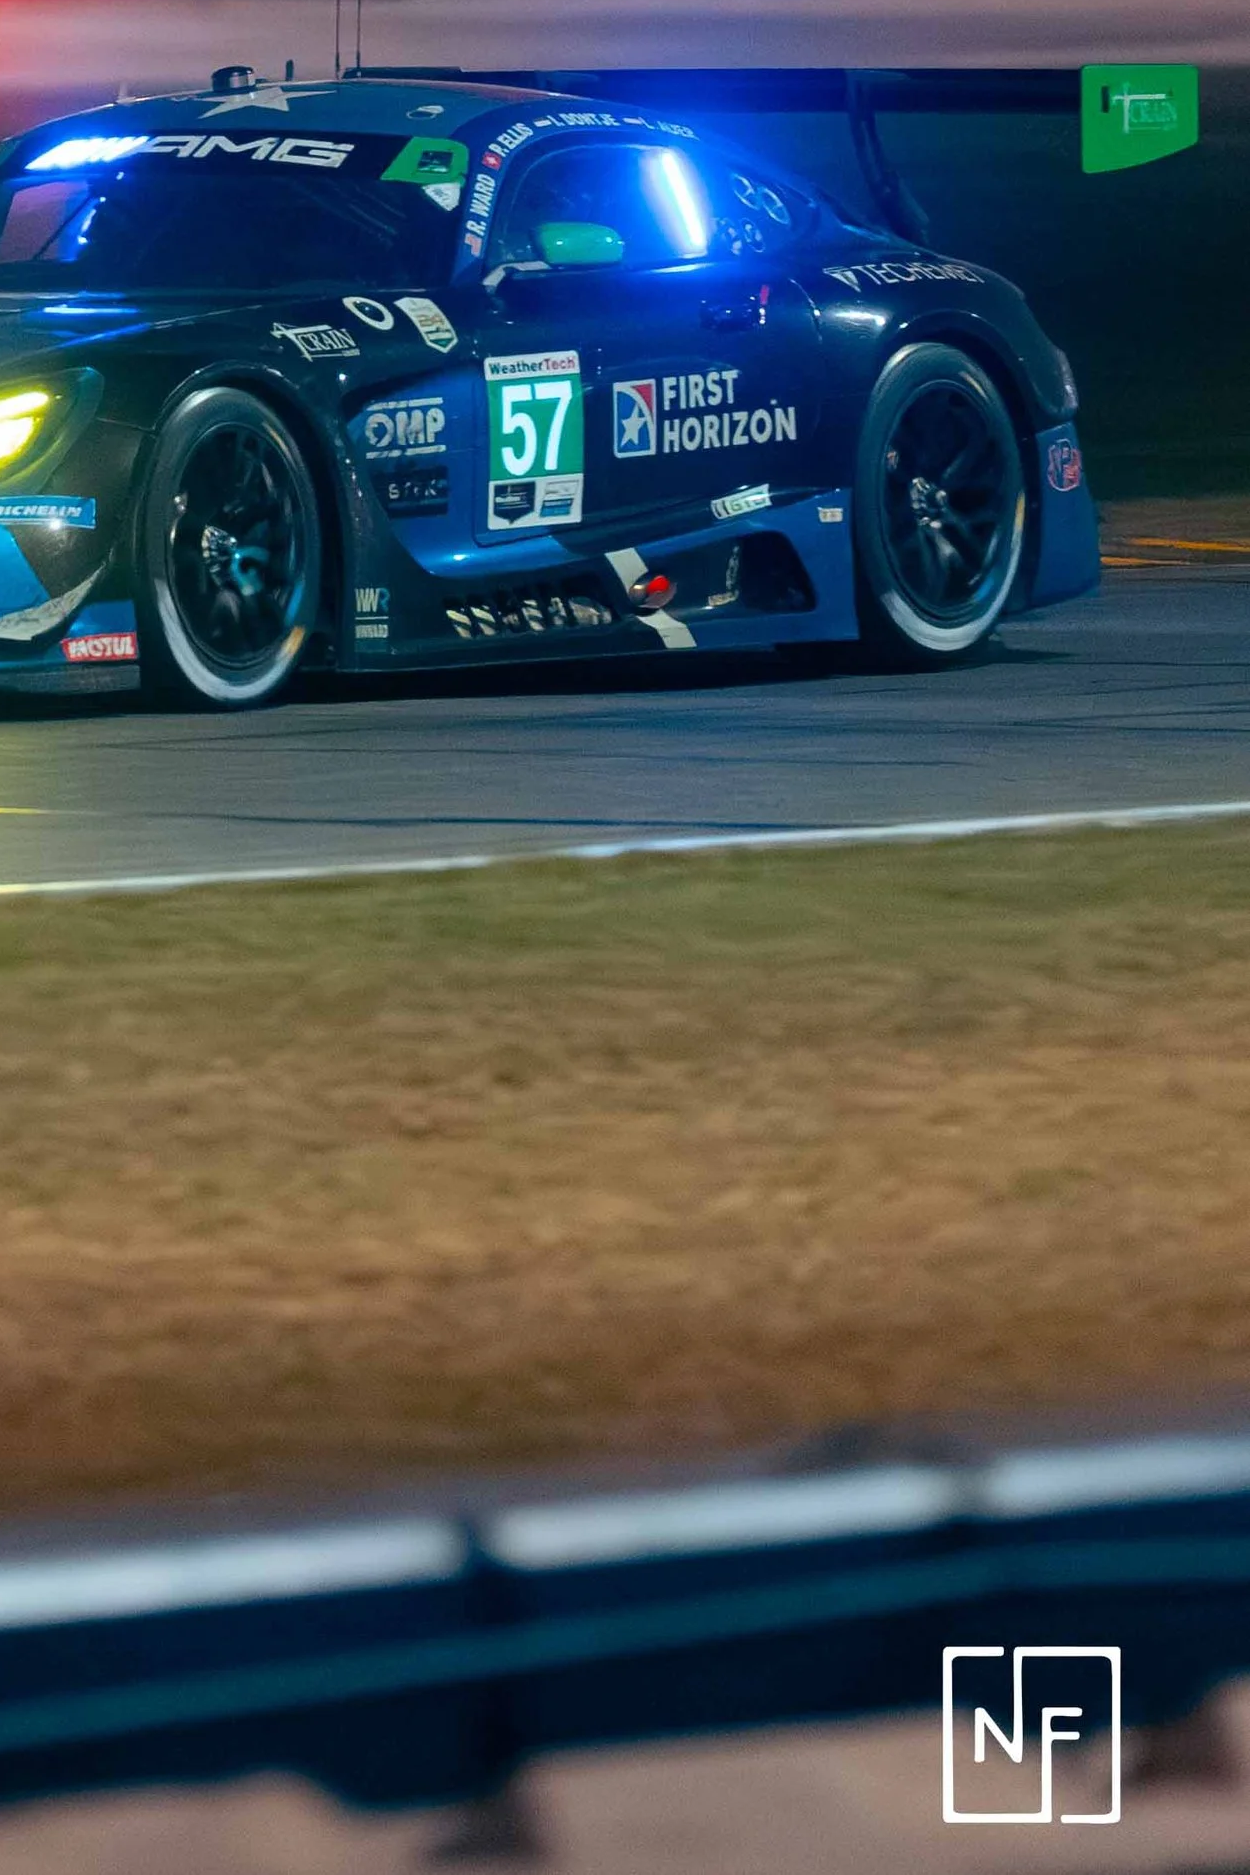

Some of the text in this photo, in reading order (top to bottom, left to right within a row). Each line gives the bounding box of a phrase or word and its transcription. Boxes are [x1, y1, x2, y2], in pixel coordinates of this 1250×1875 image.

[149, 134, 354, 168] AMG
[470, 174, 496, 217] WARD
[297, 329, 357, 352] CRAIN
[488, 356, 576, 375] WeatherTech
[662, 369, 740, 411] FIRST
[365, 407, 446, 448] OMP
[501, 380, 573, 476] 57
[663, 406, 797, 453] HORIZON
[68, 635, 135, 657] MOTUL
